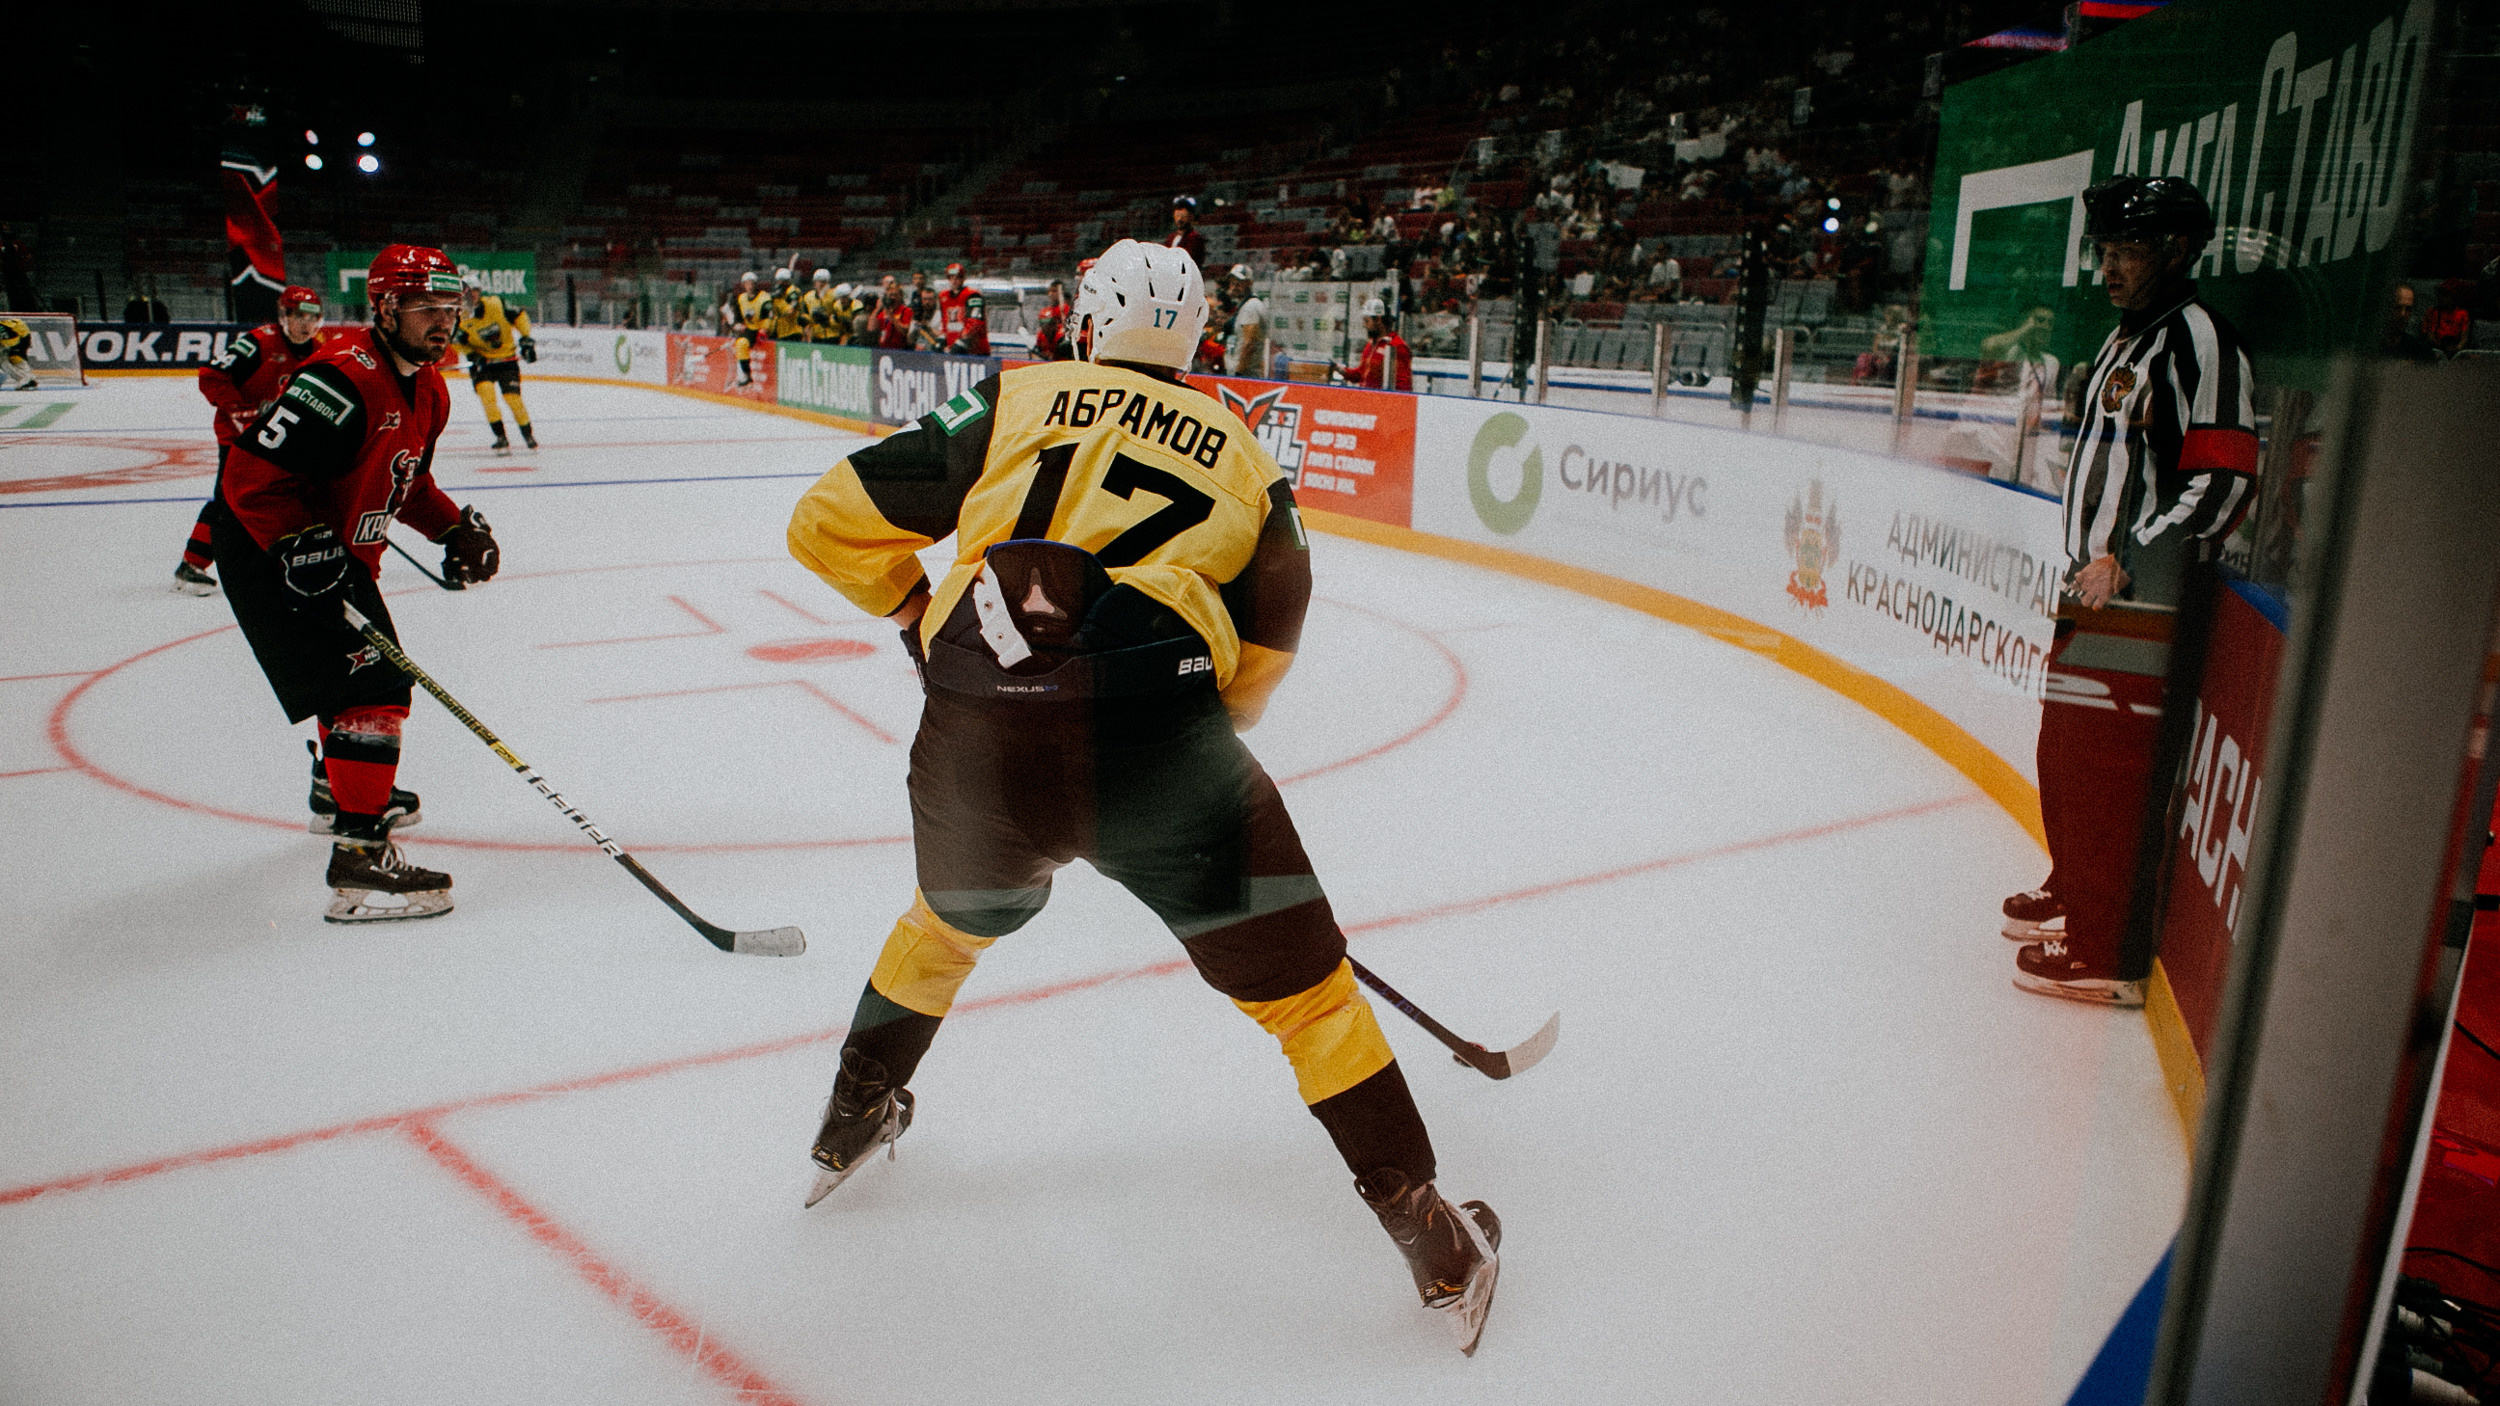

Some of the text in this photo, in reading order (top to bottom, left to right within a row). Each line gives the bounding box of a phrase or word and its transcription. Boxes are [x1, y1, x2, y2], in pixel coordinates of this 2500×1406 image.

[1153, 307, 1178, 330] 17
[257, 404, 301, 450] 5
[1044, 388, 1229, 471] АБРАМОВ
[1009, 442, 1217, 569] 17
[1560, 444, 1708, 525] Сириус
